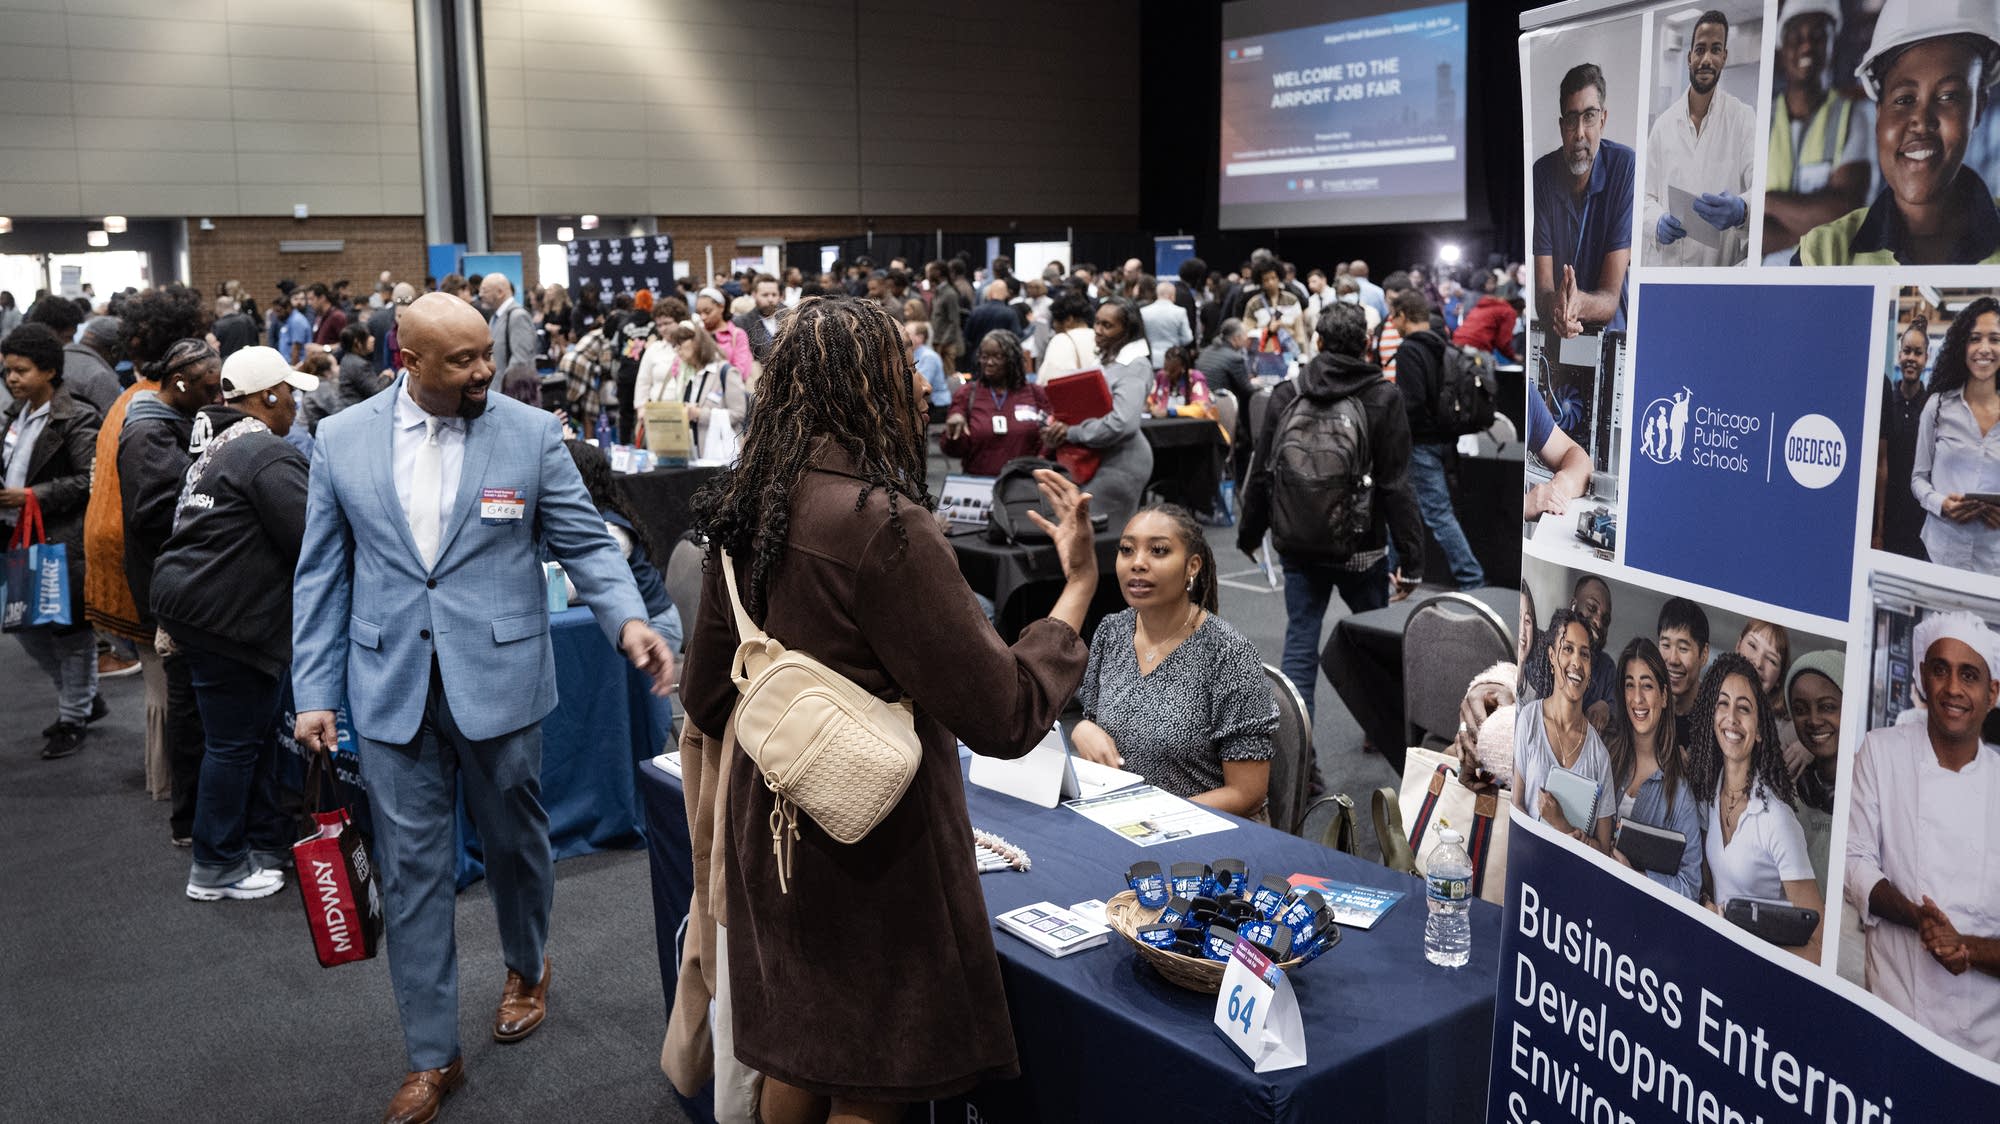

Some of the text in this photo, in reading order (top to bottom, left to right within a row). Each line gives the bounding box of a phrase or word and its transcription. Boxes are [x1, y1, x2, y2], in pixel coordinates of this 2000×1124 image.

[1272, 57, 1399, 88] WELCOME TO THE
[1270, 79, 1401, 109] AIRPORT JOB FAIR
[1695, 406, 1760, 434] Chicago
[1694, 427, 1739, 450] Public
[1788, 436, 1842, 468] OBEDESG
[1692, 447, 1749, 473] Schools
[312, 860, 353, 953] MIDWAY
[1519, 881, 1683, 1030] Business
[1228, 984, 1256, 1034] 64
[1514, 951, 1764, 1124] Developme
[1506, 1091, 1542, 1124] S
